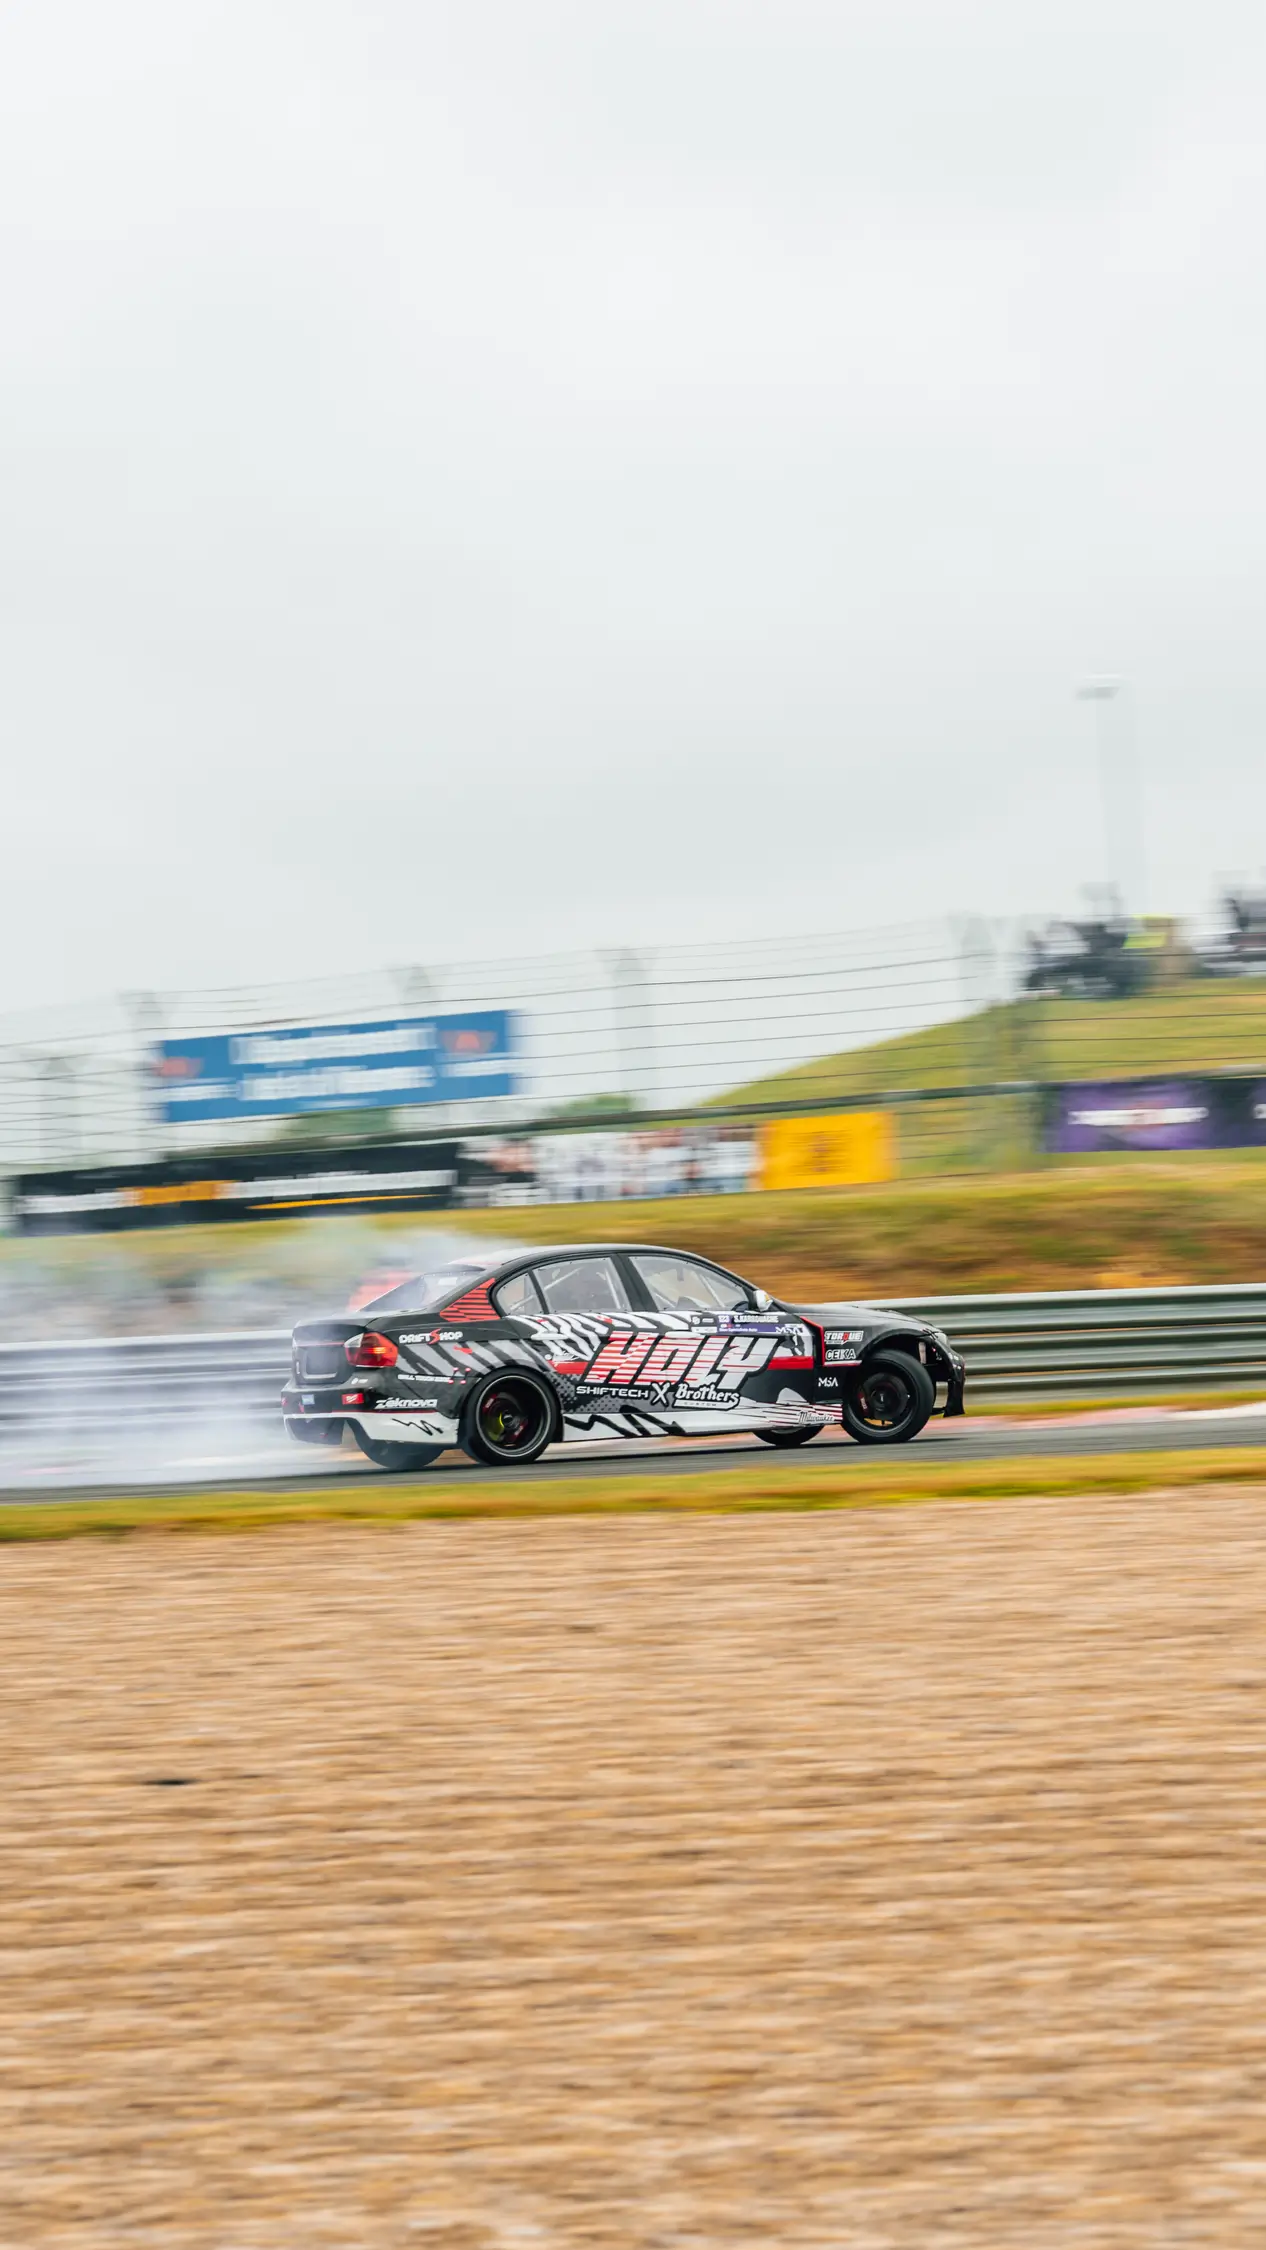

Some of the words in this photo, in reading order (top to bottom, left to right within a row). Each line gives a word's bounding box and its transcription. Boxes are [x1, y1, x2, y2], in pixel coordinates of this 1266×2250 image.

[826, 1332, 862, 1340] TORQUE
[825, 1348, 857, 1361] CEIKA
[576, 1385, 649, 1398] SHIFTECH
[675, 1383, 740, 1404] Brothers
